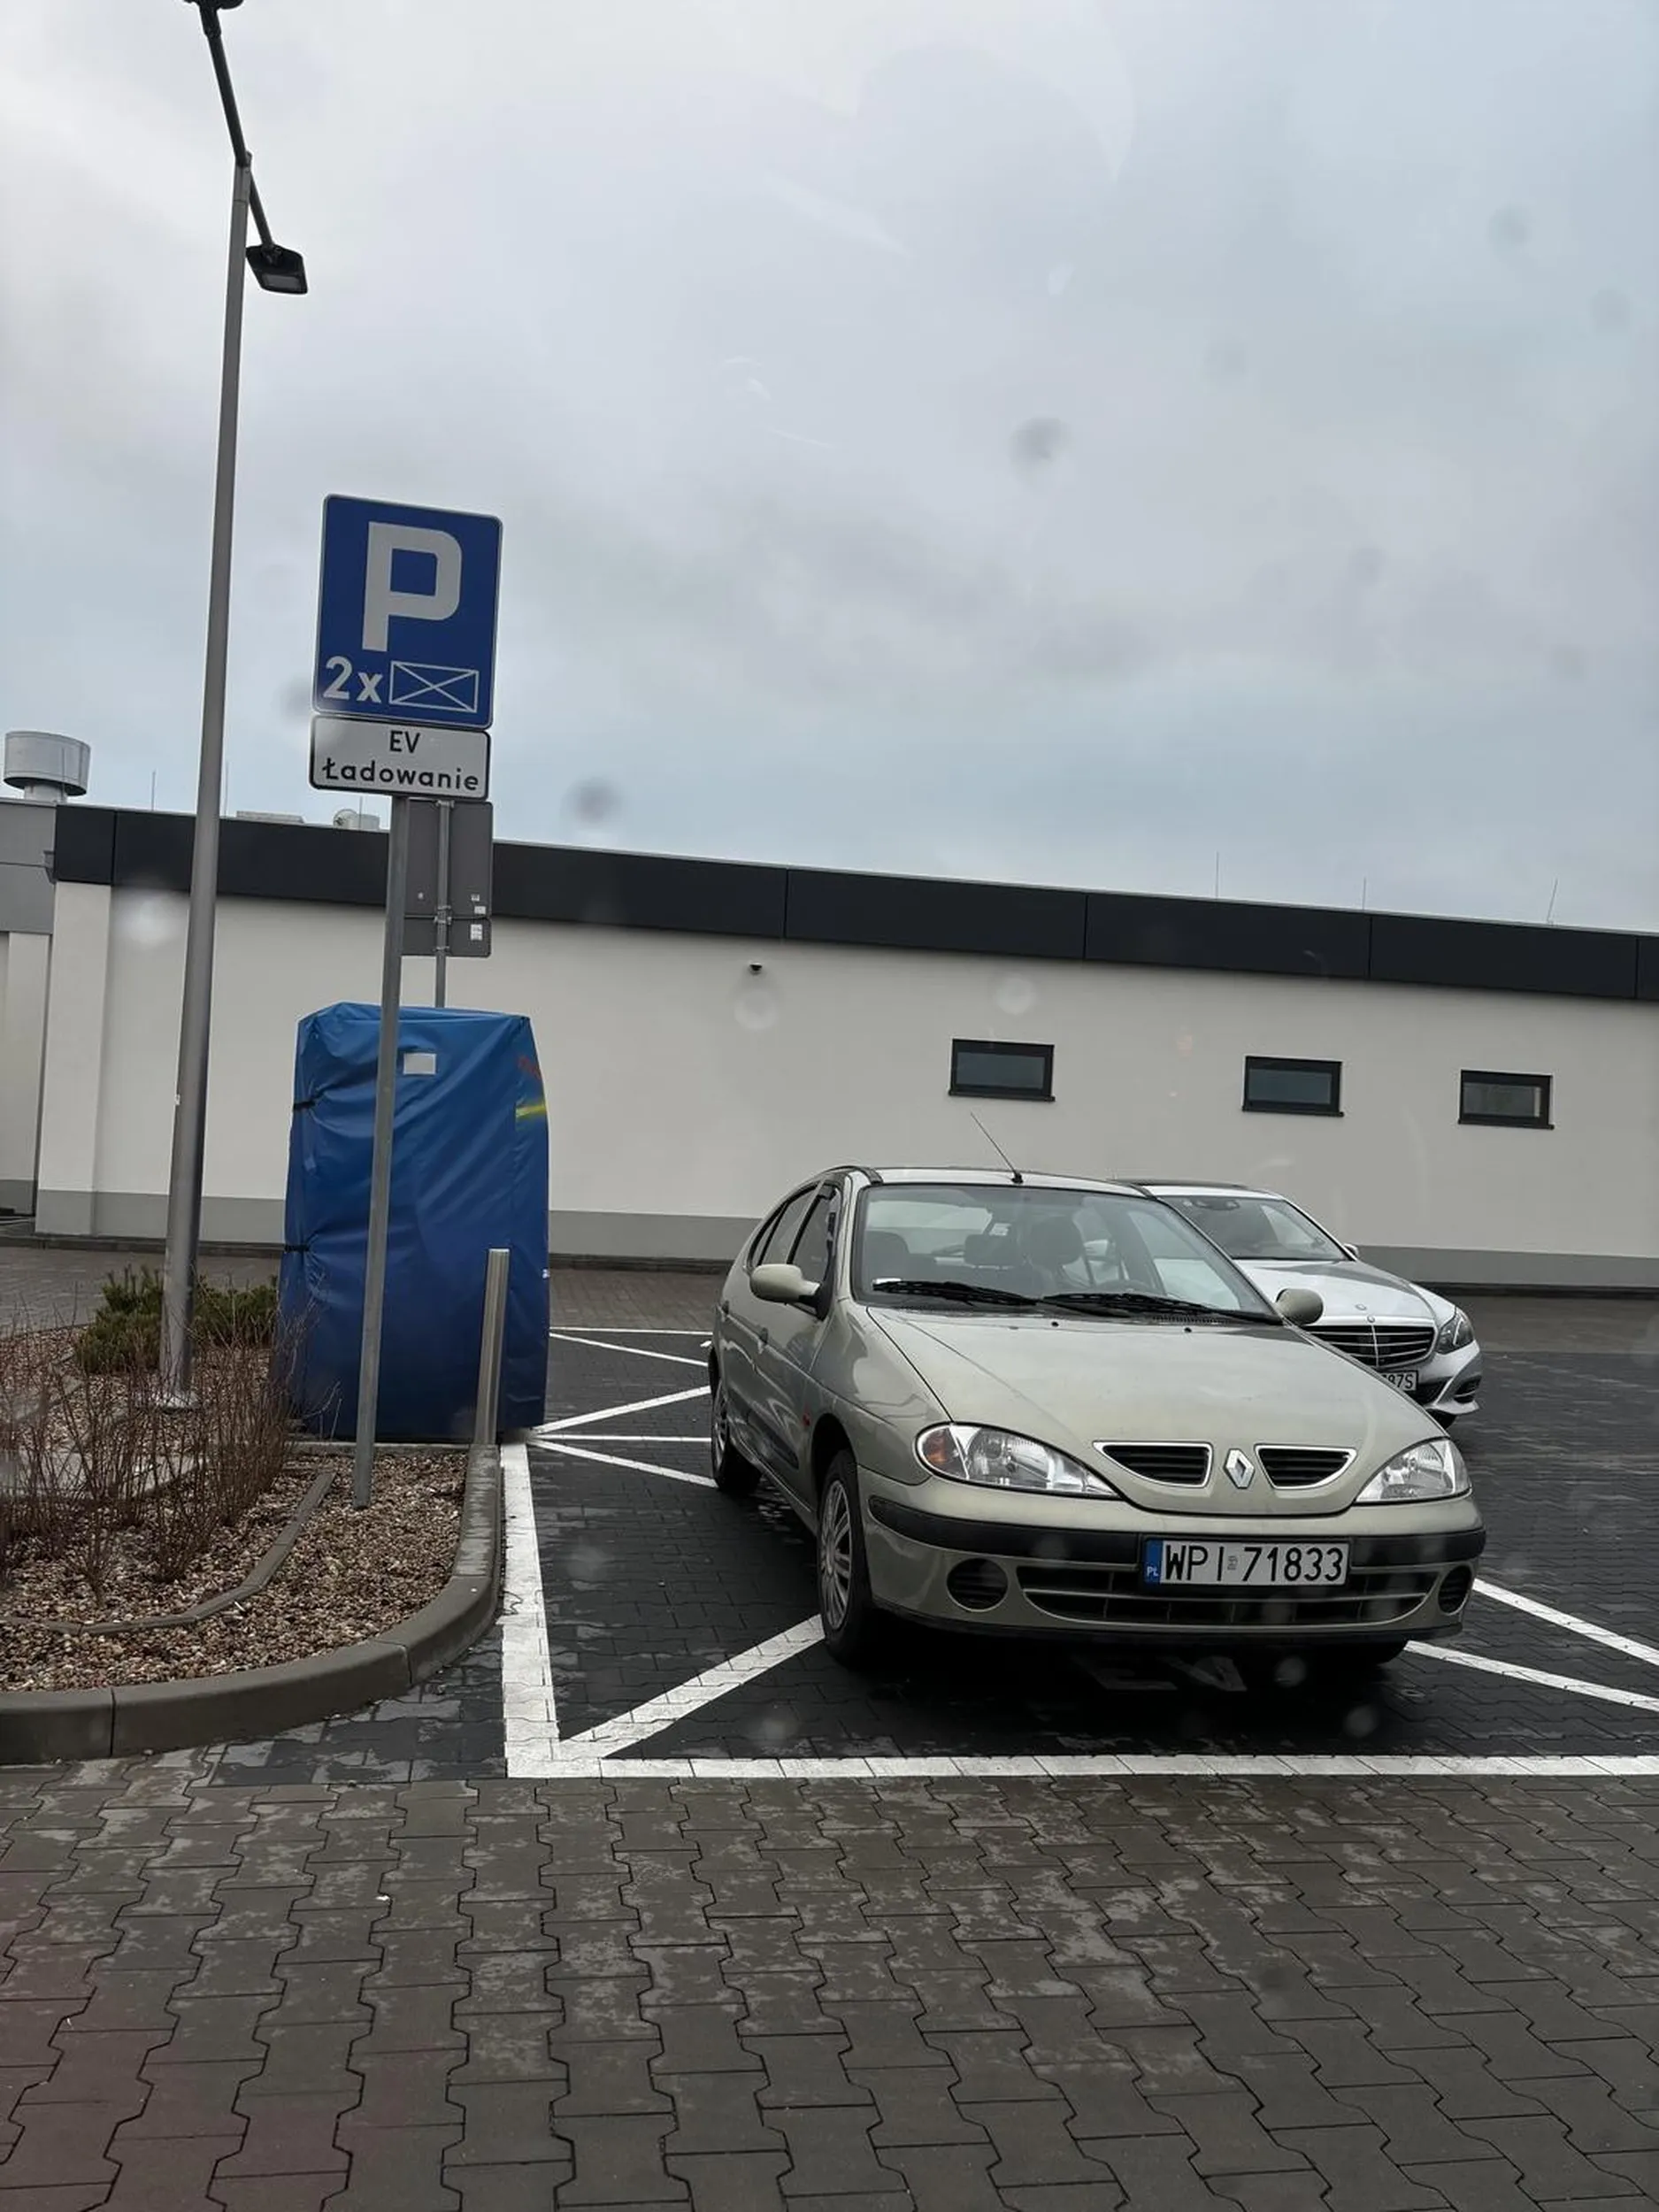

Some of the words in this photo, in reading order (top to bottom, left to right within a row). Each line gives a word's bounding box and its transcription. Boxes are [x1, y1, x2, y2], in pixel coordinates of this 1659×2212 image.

[362, 521, 463, 652] P
[323, 656, 383, 704] 2x
[388, 730, 421, 754] EV
[322, 757, 480, 791] Ładowanie
[1146, 1566, 1159, 1578] PL
[1165, 1544, 1225, 1582] WPI
[1242, 1546, 1344, 1582] 71833
